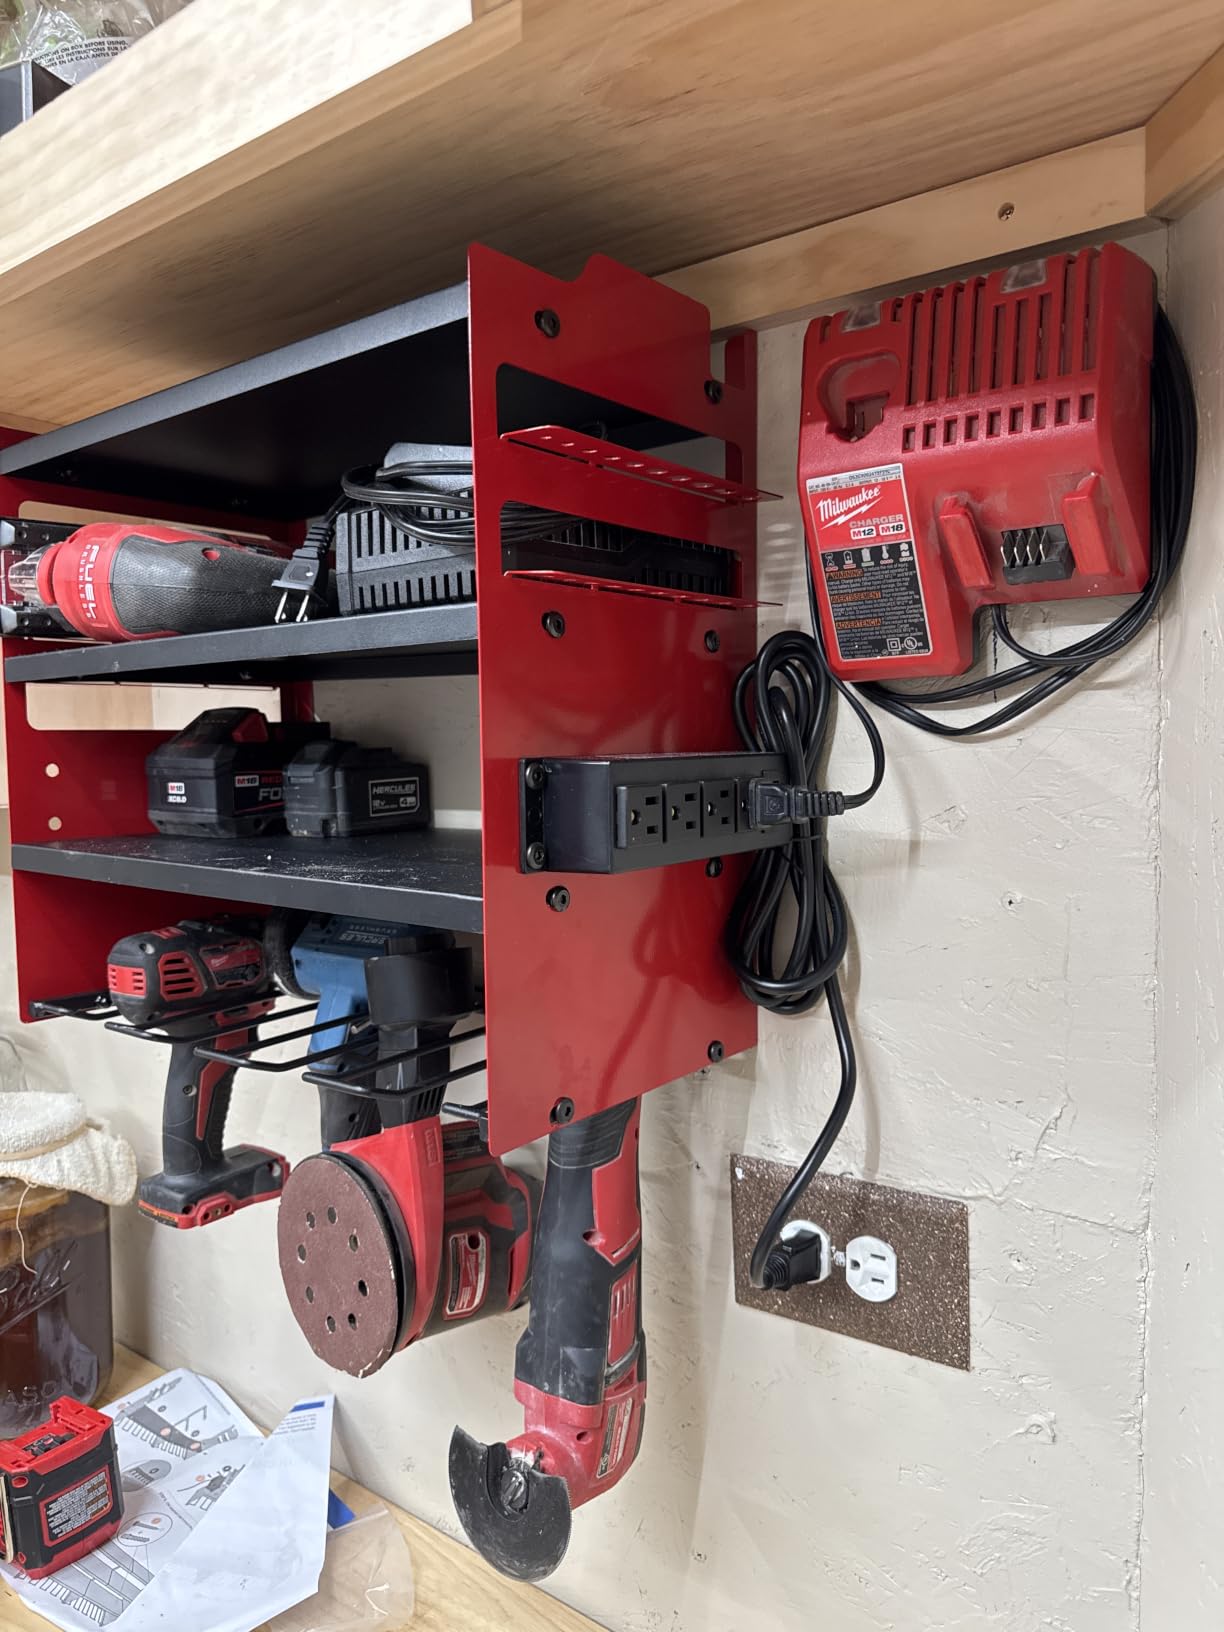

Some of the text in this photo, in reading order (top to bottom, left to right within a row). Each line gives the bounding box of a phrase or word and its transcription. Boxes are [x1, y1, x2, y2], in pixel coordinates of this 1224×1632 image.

[66, 46, 106, 57] INSTRUCTIONS
[85, 41, 105, 49] BEFORE
[815, 487, 880, 522] Milwaukee
[849, 514, 904, 528] CHARGER
[852, 524, 904, 538] M12 M18
[79, 544, 92, 618] BRUSHLESS
[85, 544, 100, 619] FUEL
[237, 777, 257, 786] M18
[259, 788, 282, 801] FO
[372, 783, 416, 795] HERCULES
[339, 933, 385, 945] ERCULES
